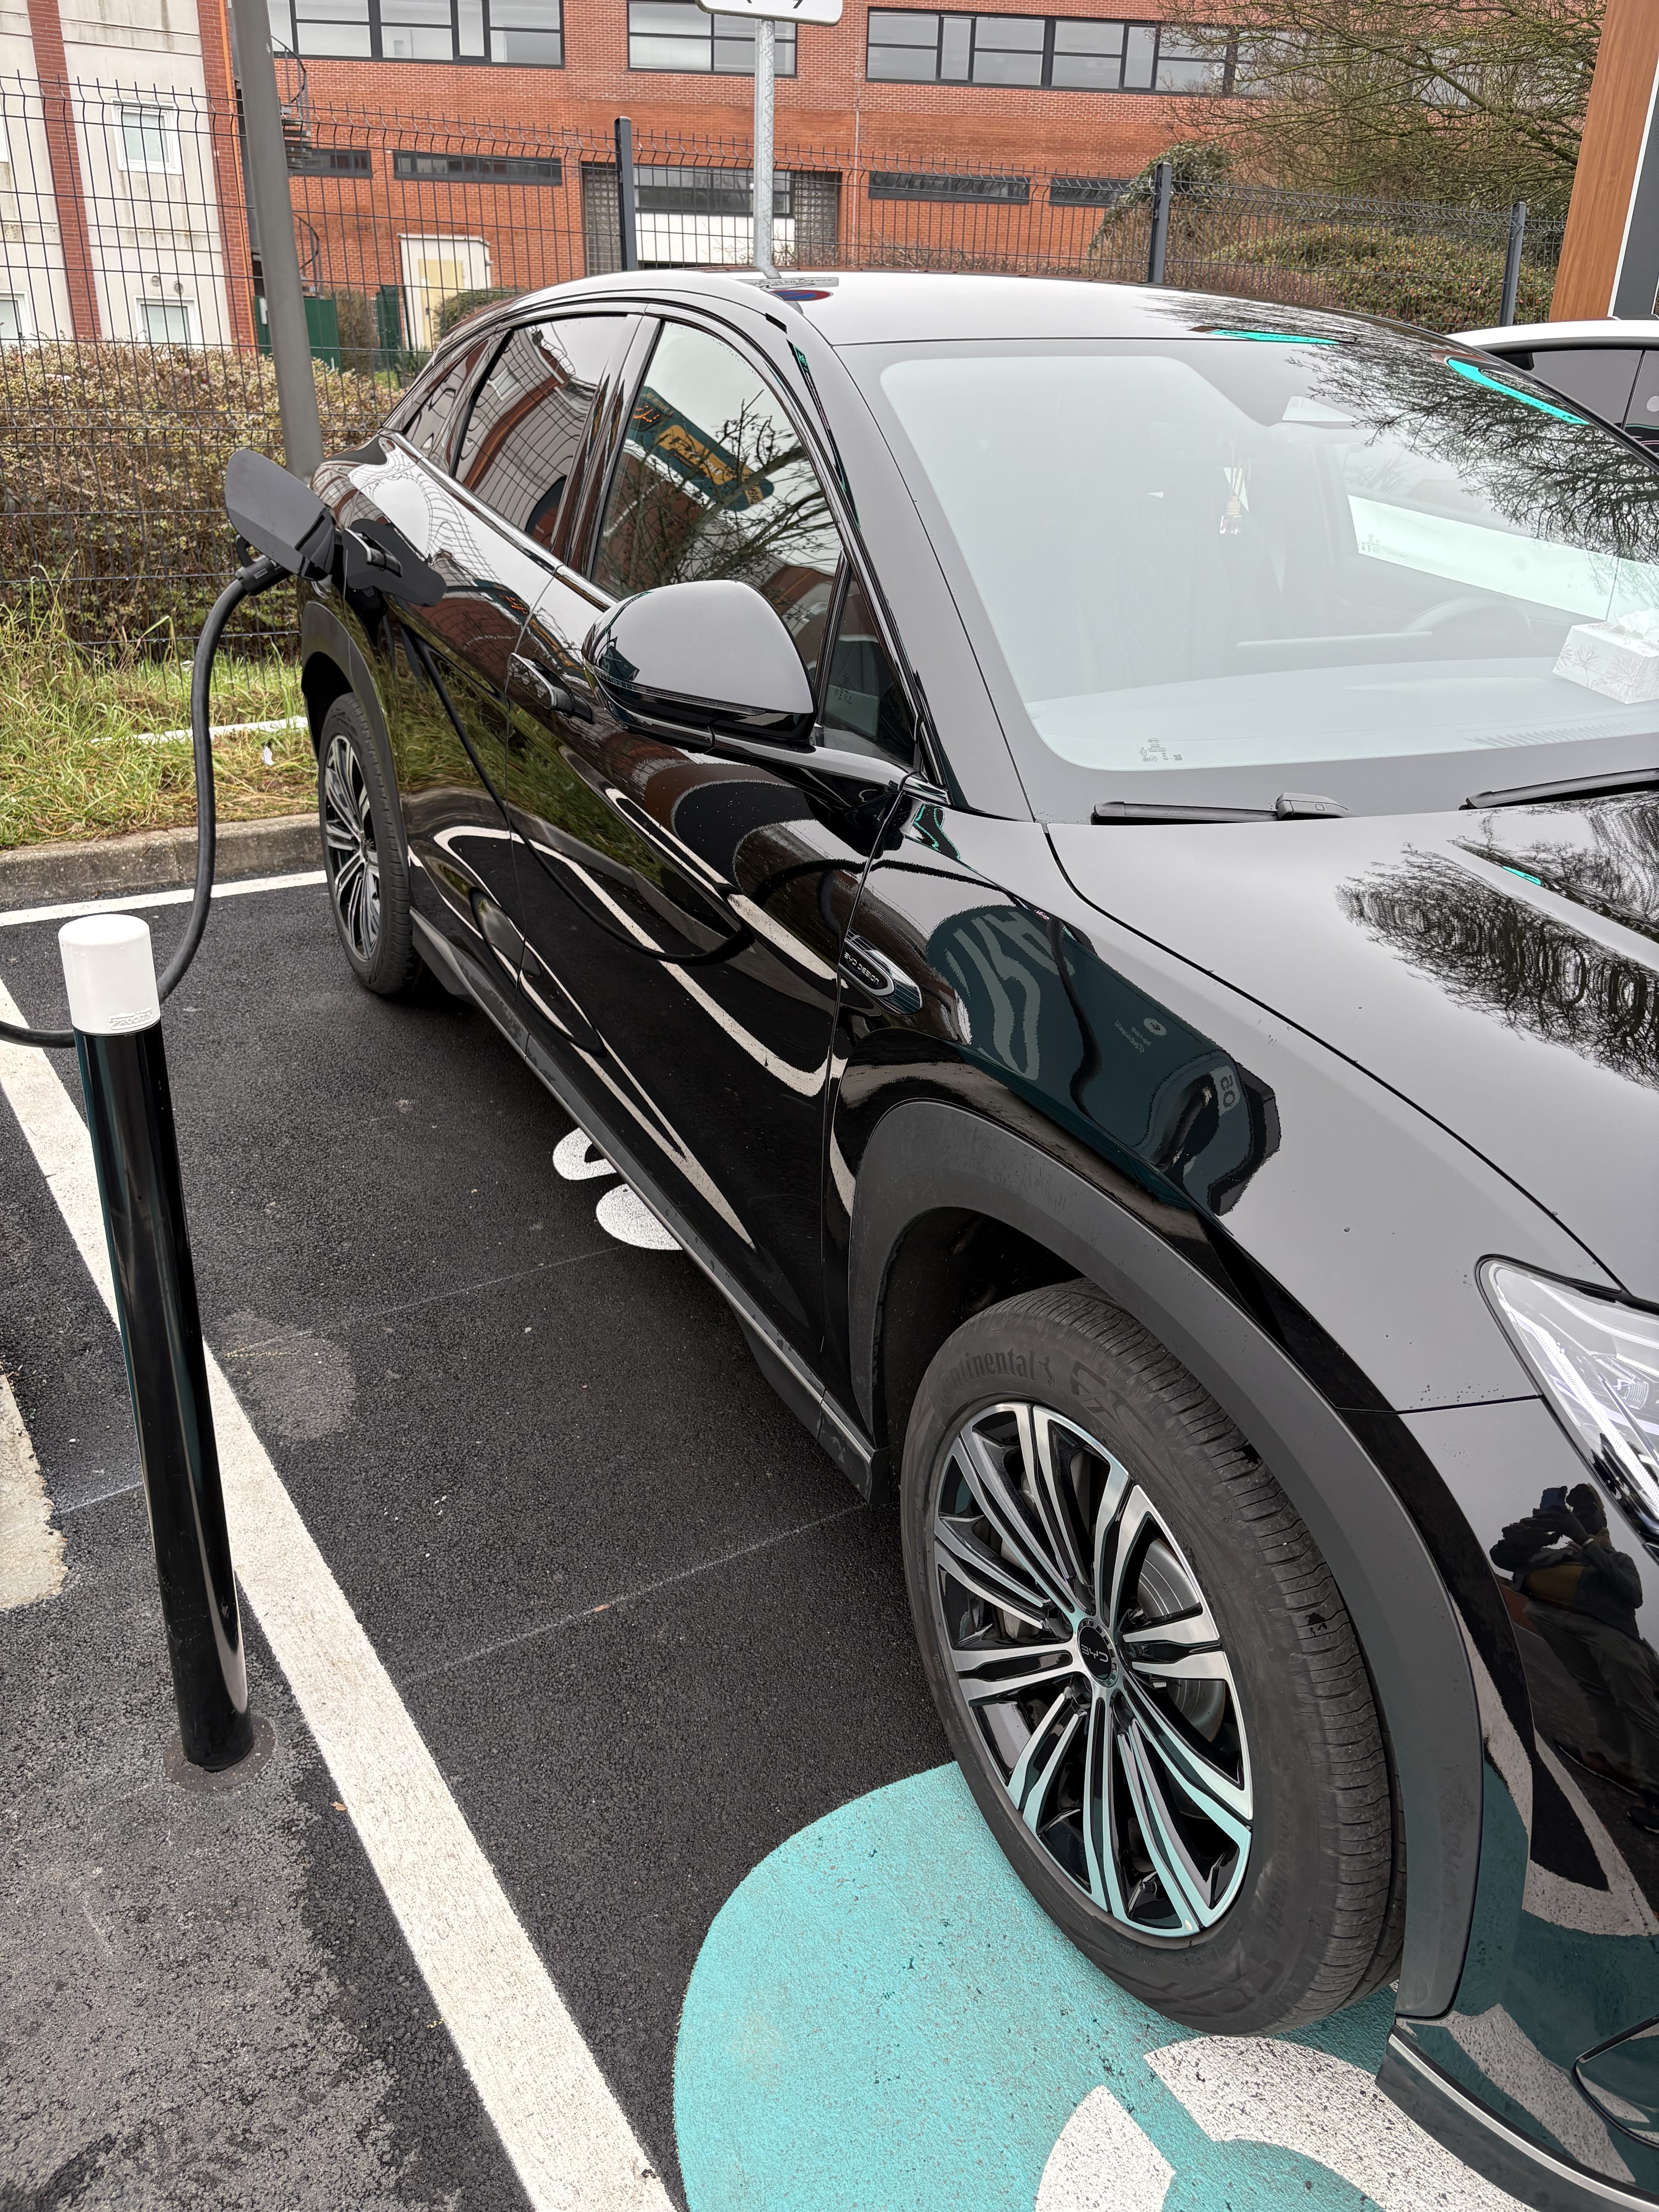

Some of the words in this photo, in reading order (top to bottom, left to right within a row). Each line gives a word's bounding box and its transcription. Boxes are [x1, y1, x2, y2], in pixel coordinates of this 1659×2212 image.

[844, 952, 857, 966] BYD
[857, 963, 879, 985] DESIGN
[937, 1348, 1037, 1407] Continental
[1080, 1644, 1109, 1662] BYD
